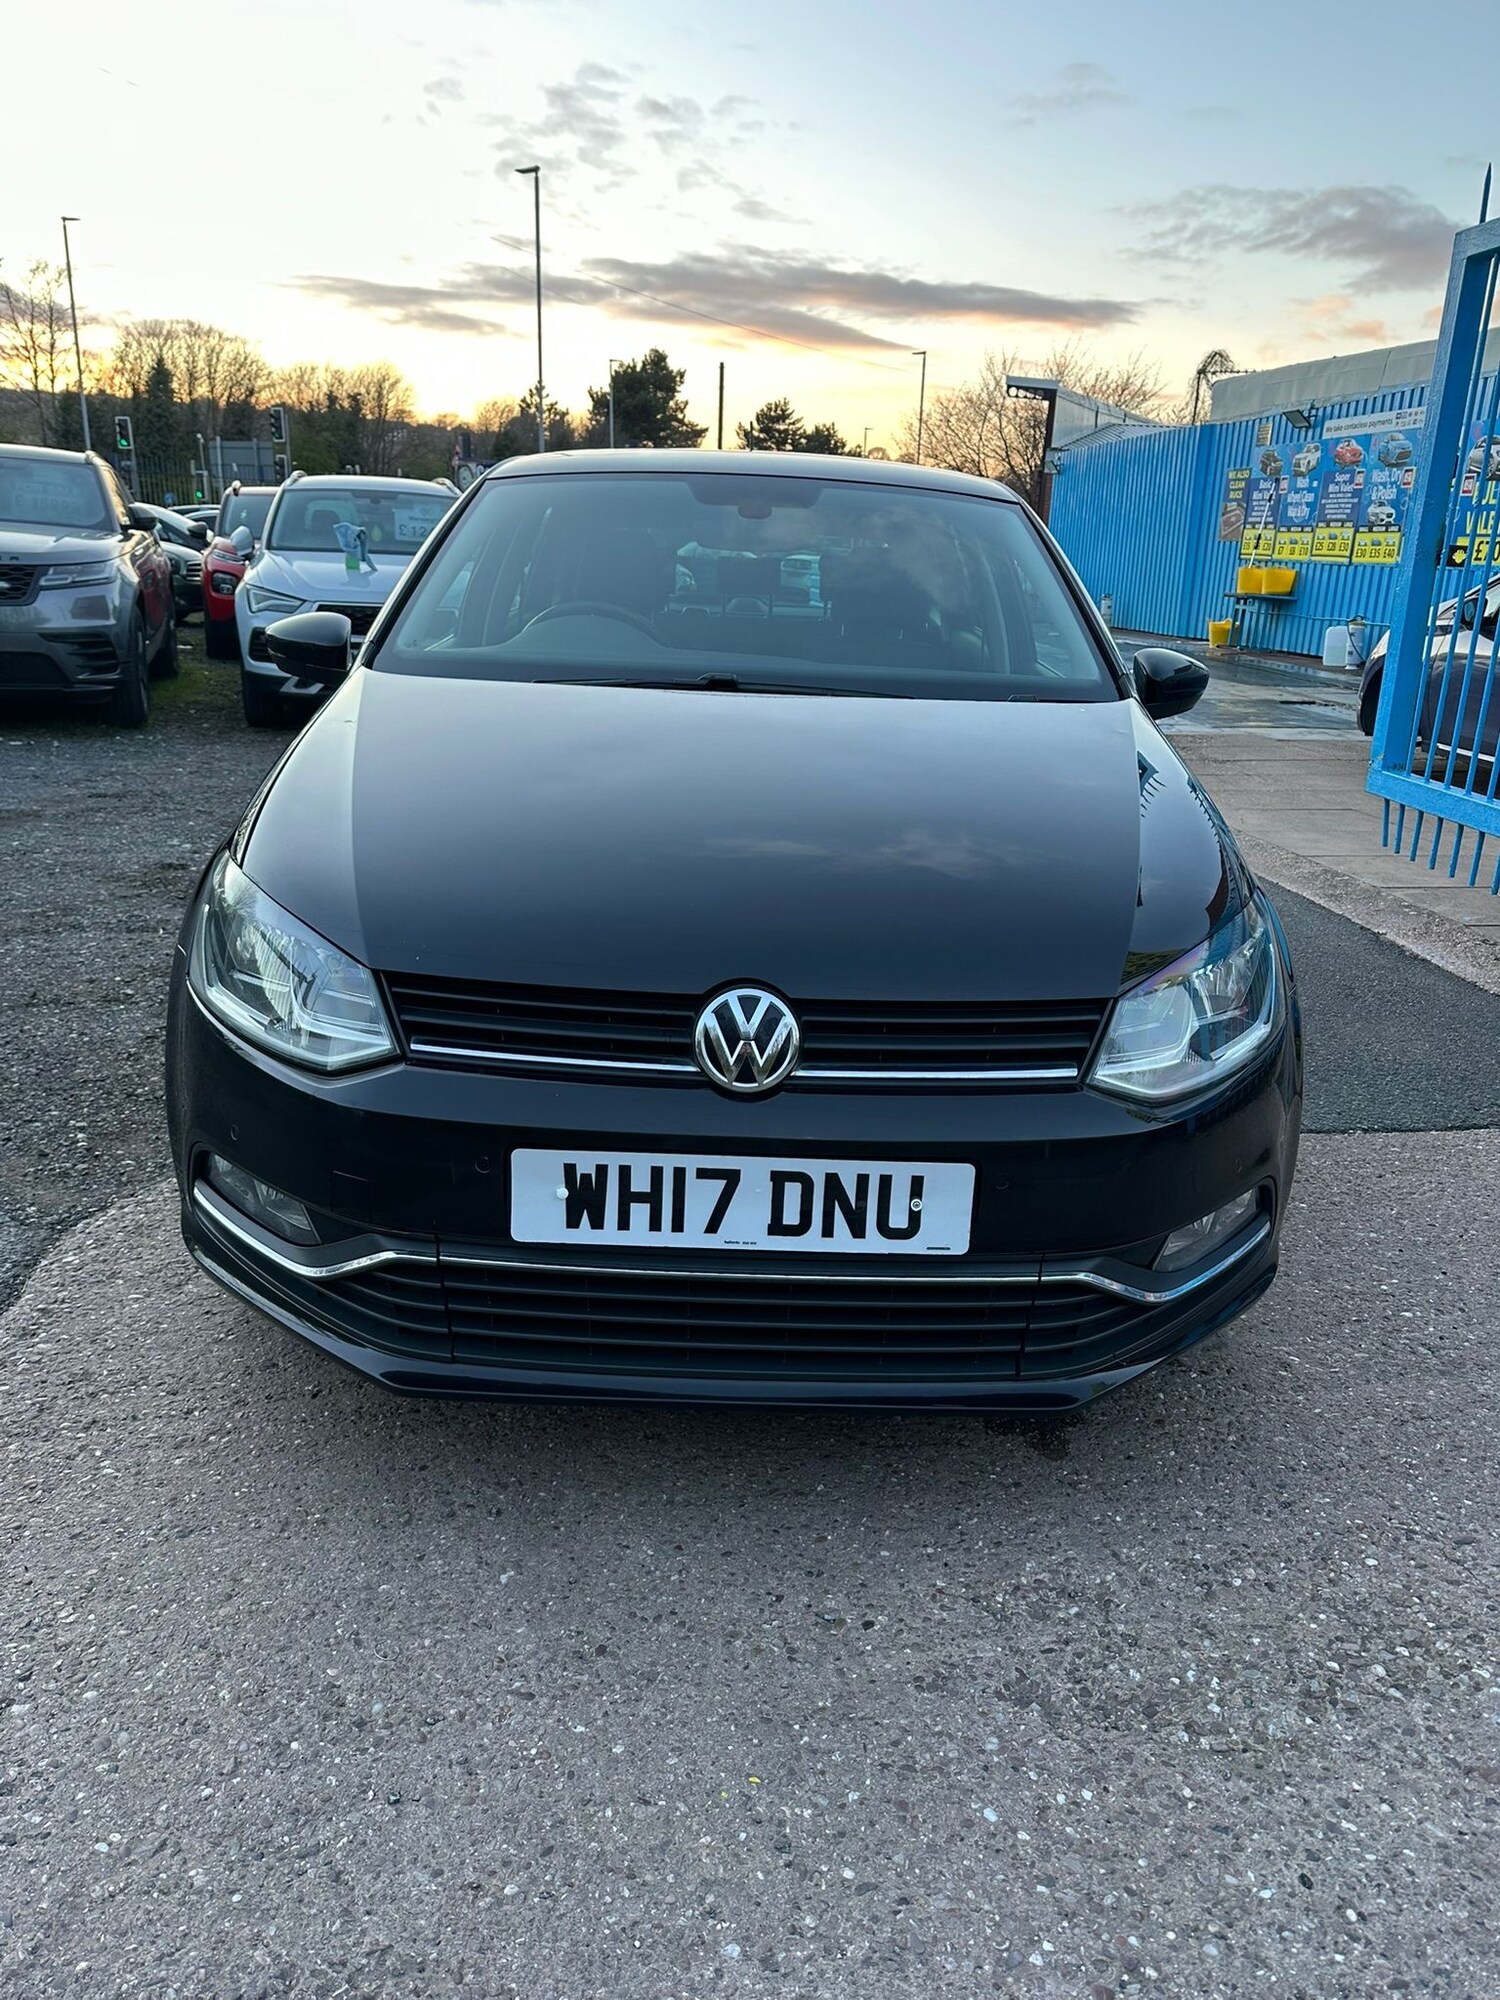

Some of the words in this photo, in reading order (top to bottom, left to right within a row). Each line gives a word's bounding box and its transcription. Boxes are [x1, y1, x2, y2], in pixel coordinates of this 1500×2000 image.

[1334, 424, 1343, 432] take
[1344, 421, 1368, 430] contactless
[1368, 418, 1393, 429] payments
[1228, 471, 1237, 479] WE
[1237, 470, 1250, 478] ALSO
[1334, 472, 1351, 484] Super
[1391, 468, 1402, 485] Dry
[1230, 480, 1246, 489] CLEAN
[1259, 479, 1272, 489] Basic
[1328, 484, 1339, 493] Mini
[1340, 482, 1354, 492] Valet
[1252, 490, 1262, 500] Mini
[1264, 490, 1276, 500] Vat
[1287, 490, 1302, 502] Wheel
[1302, 490, 1314, 502] Clean
[1372, 489, 1378, 500] &
[1378, 486, 1397, 500] Polish
[1278, 546, 1284, 555] £7
[1299, 547, 1308, 556] £10
[1315, 542, 1324, 551] £25
[1338, 542, 1349, 552] £30
[1355, 548, 1366, 558] £30
[1369, 548, 1381, 558] £35
[1383, 548, 1395, 558] £40
[563, 1162, 742, 1235] WH17
[766, 1169, 925, 1241] DNU
